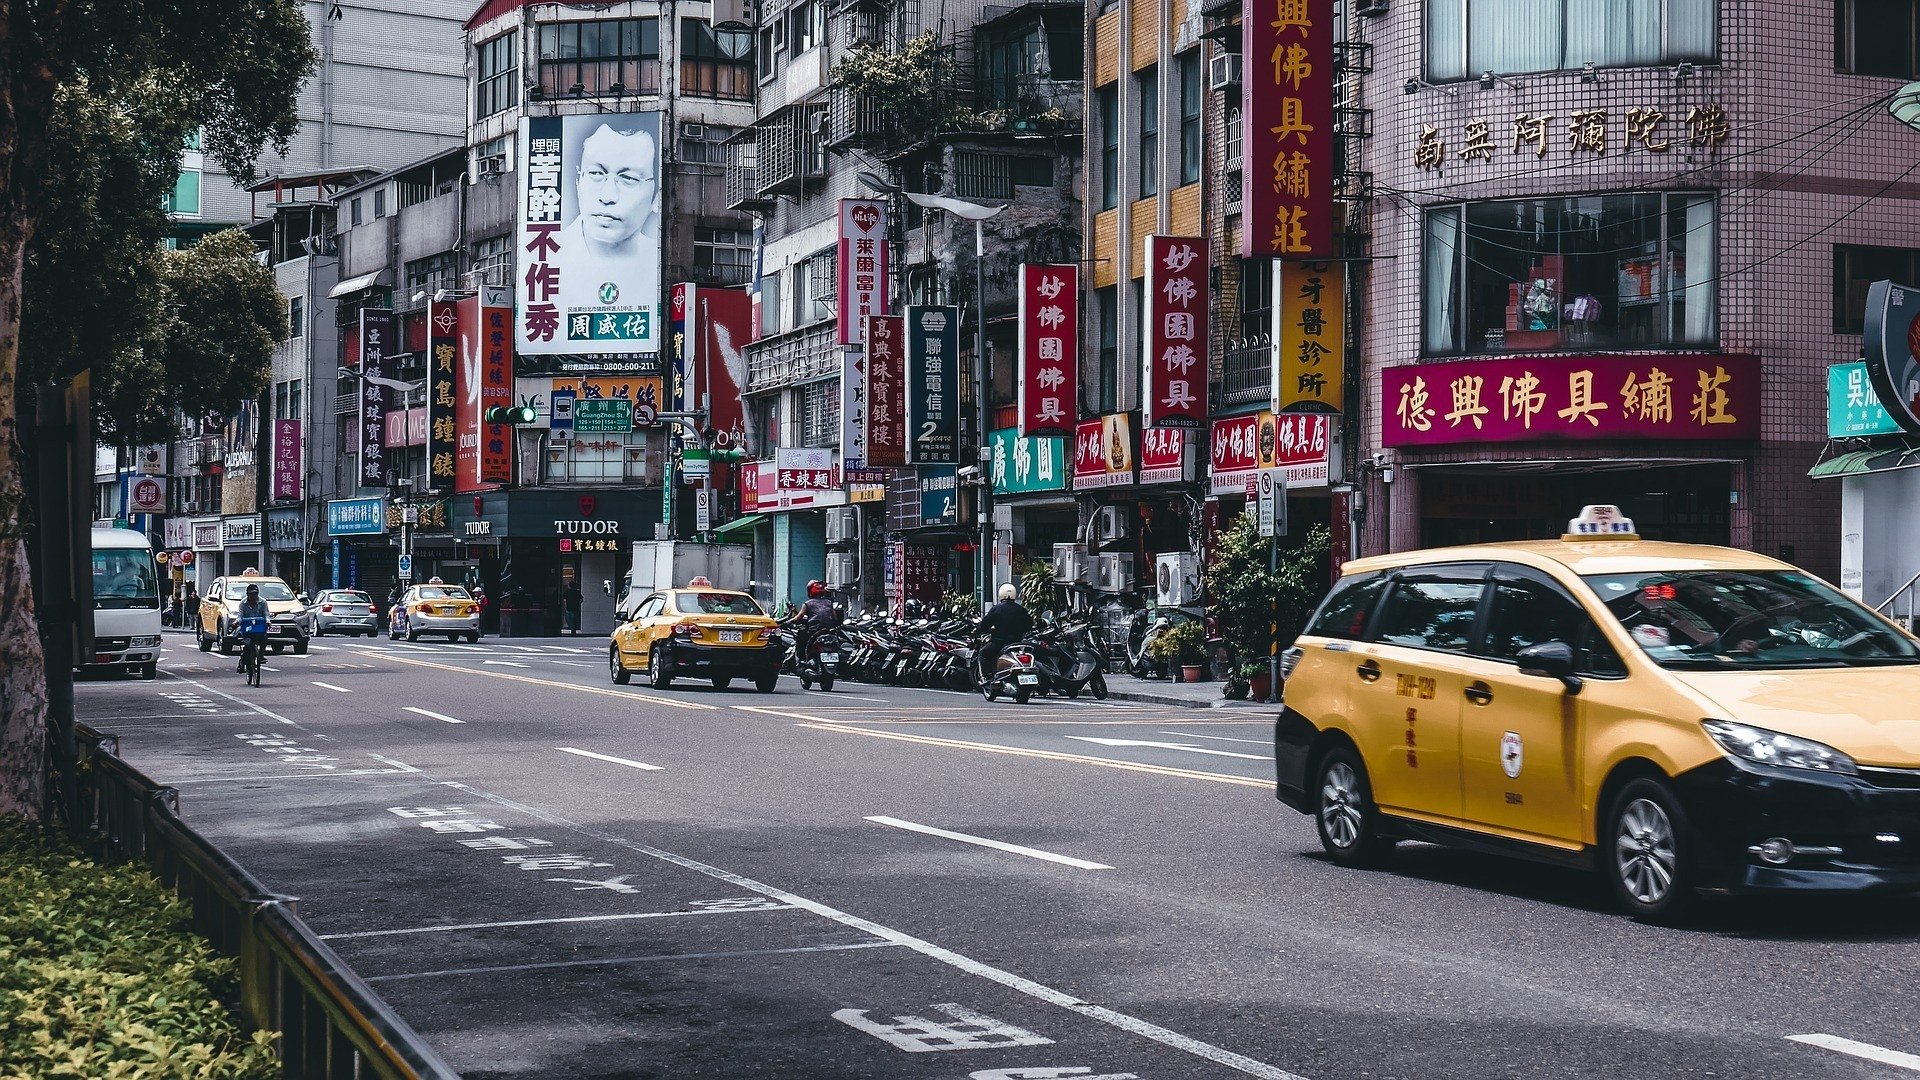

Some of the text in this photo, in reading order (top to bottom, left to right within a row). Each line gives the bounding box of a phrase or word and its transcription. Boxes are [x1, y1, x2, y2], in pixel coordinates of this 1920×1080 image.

[1412, 103, 1732, 172] 南無阿彌陀佛
[570, 313, 647, 339] 周威佑
[1161, 244, 1198, 410] 妙佛園佛具
[1036, 274, 1066, 424] 妙佛園佛具
[603, 362, 655, 371] 0800-600-211
[925, 337, 943, 411] 聯強電信
[432, 343, 456, 477] 寶島鐘錶
[579, 400, 628, 412] 廣州街
[1397, 366, 1738, 431] 德興佛具繡莊
[917, 421, 937, 442] 2
[1280, 415, 1325, 457] 佛具店
[779, 469, 830, 489] 香辣麵
[465, 521, 490, 534] TUDOR
[554, 520, 619, 534] TUDOR
[574, 538, 618, 551] 寶島鐘錶
